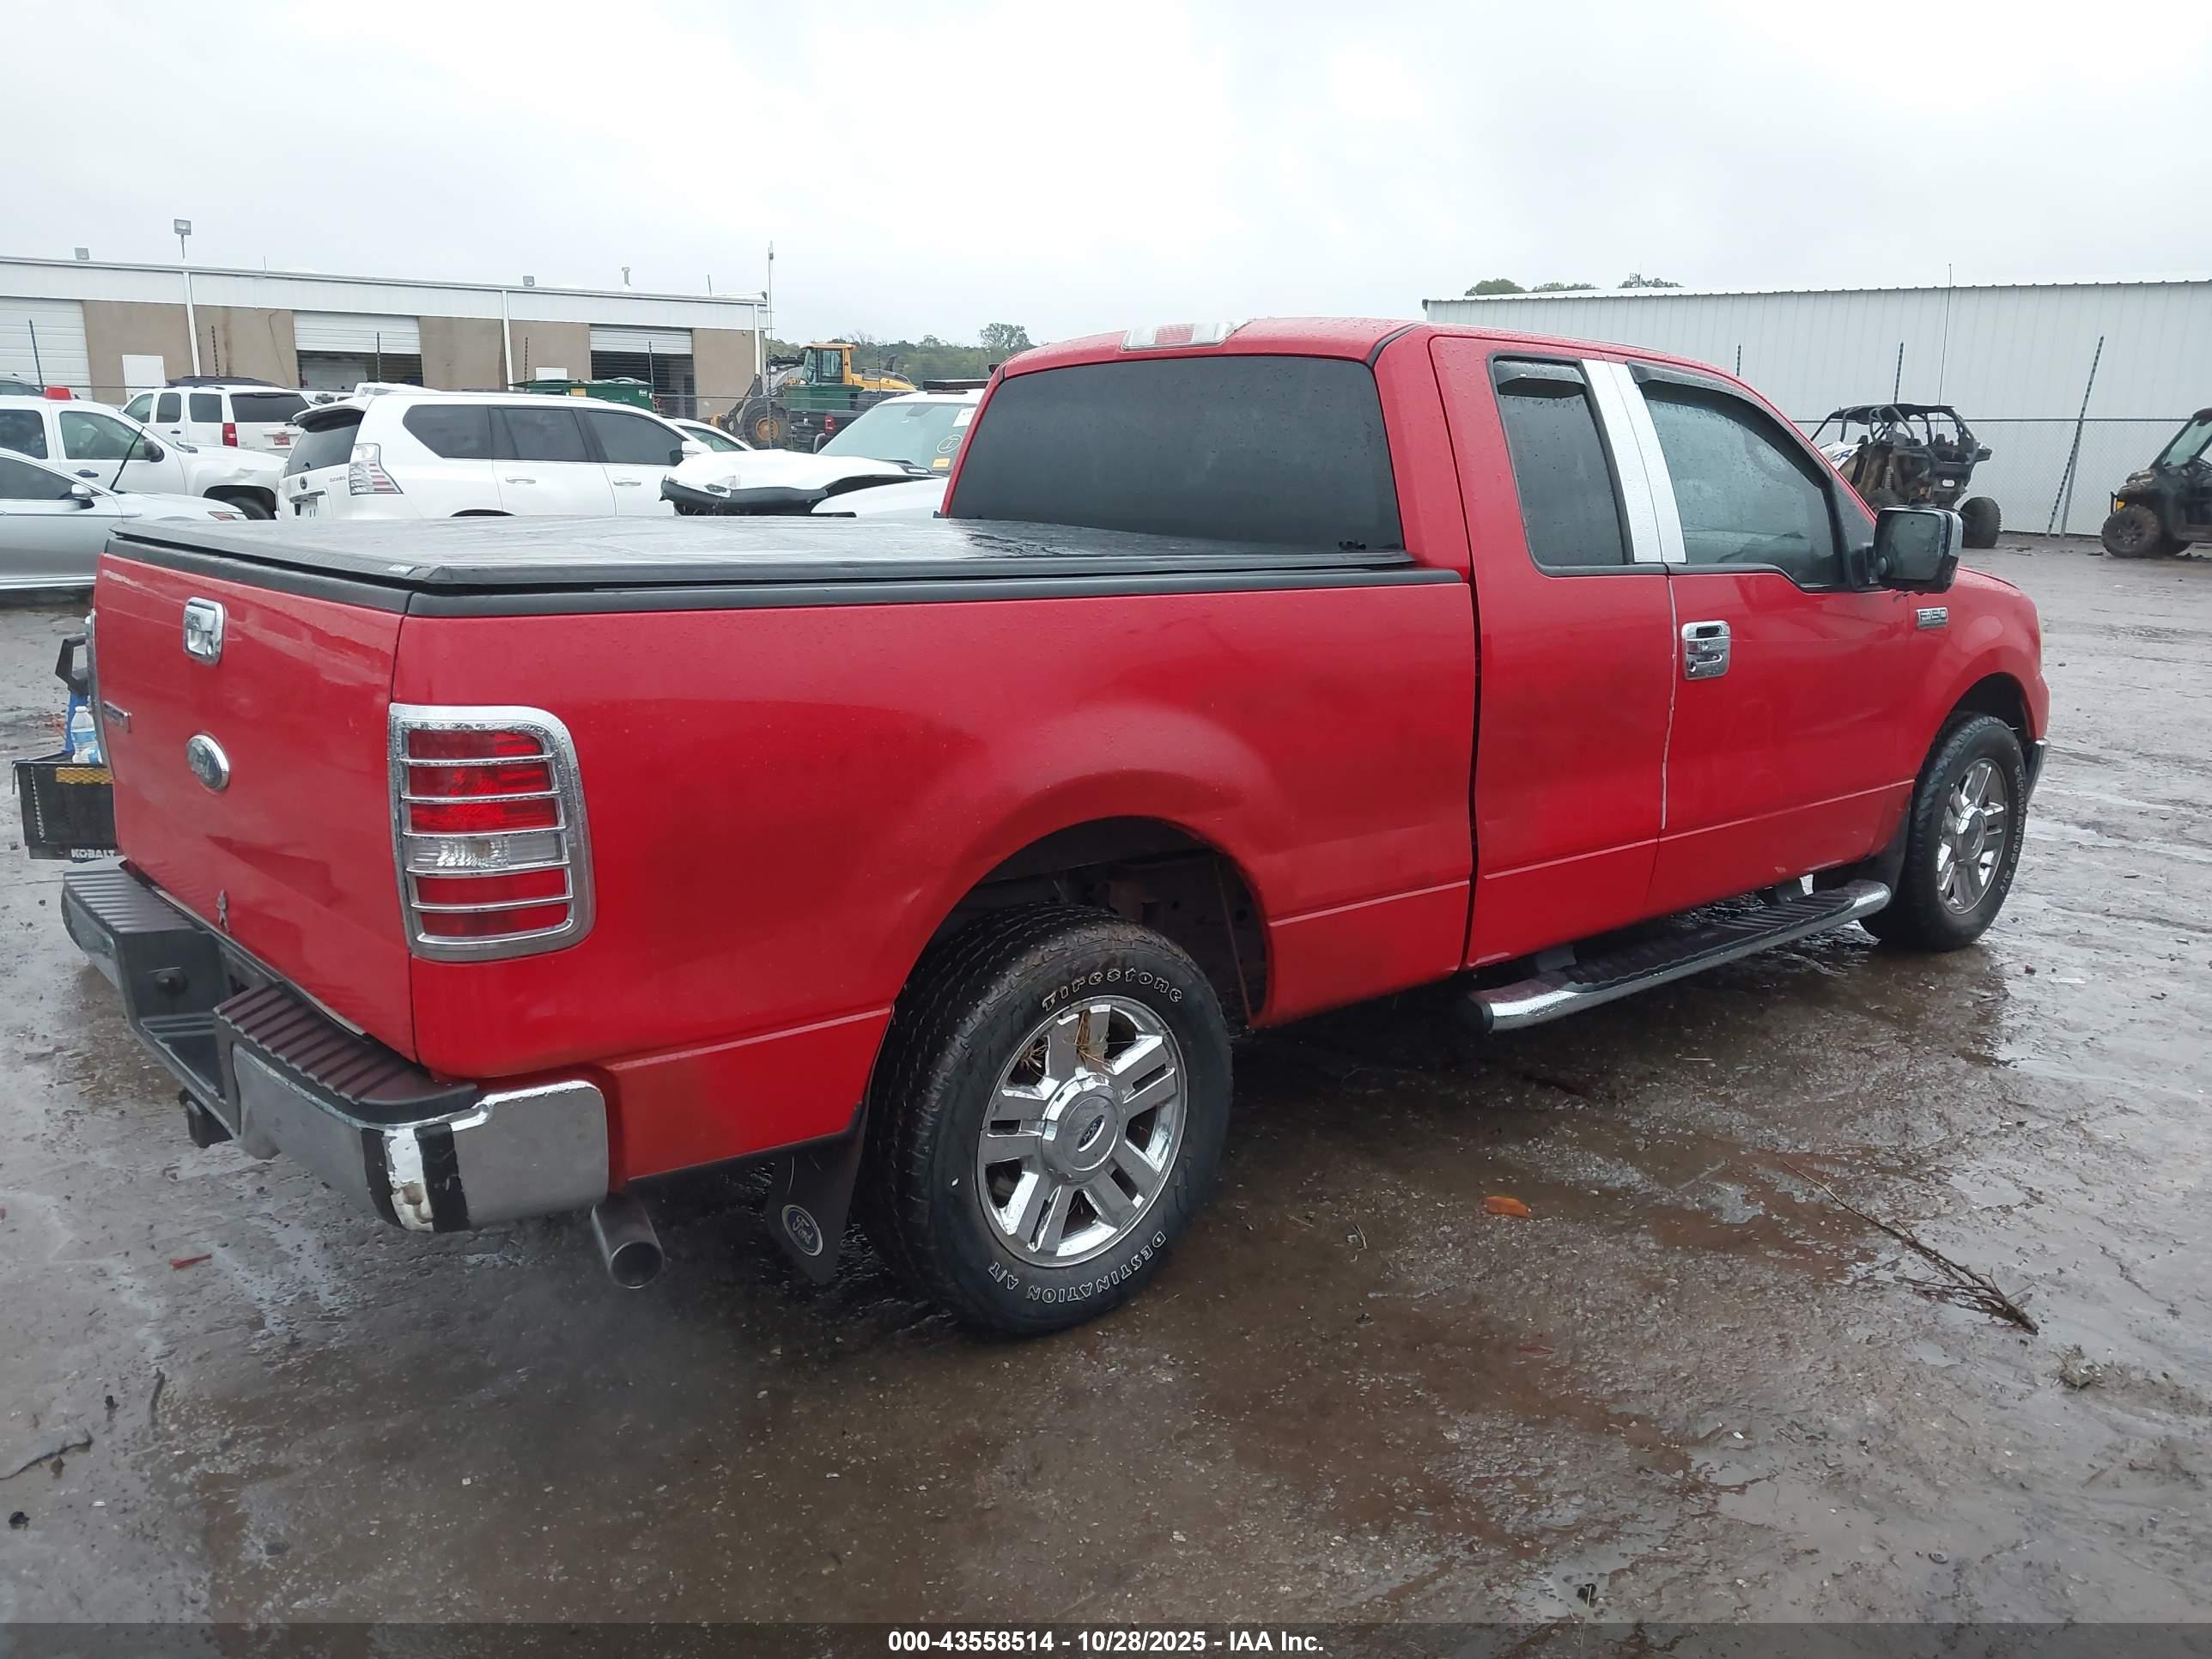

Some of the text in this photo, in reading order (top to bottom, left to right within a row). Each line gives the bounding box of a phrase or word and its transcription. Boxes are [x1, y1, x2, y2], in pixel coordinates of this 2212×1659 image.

[70, 848, 115, 860] KOBALT
[988, 1231, 1168, 1304] DESTINATION A/T
